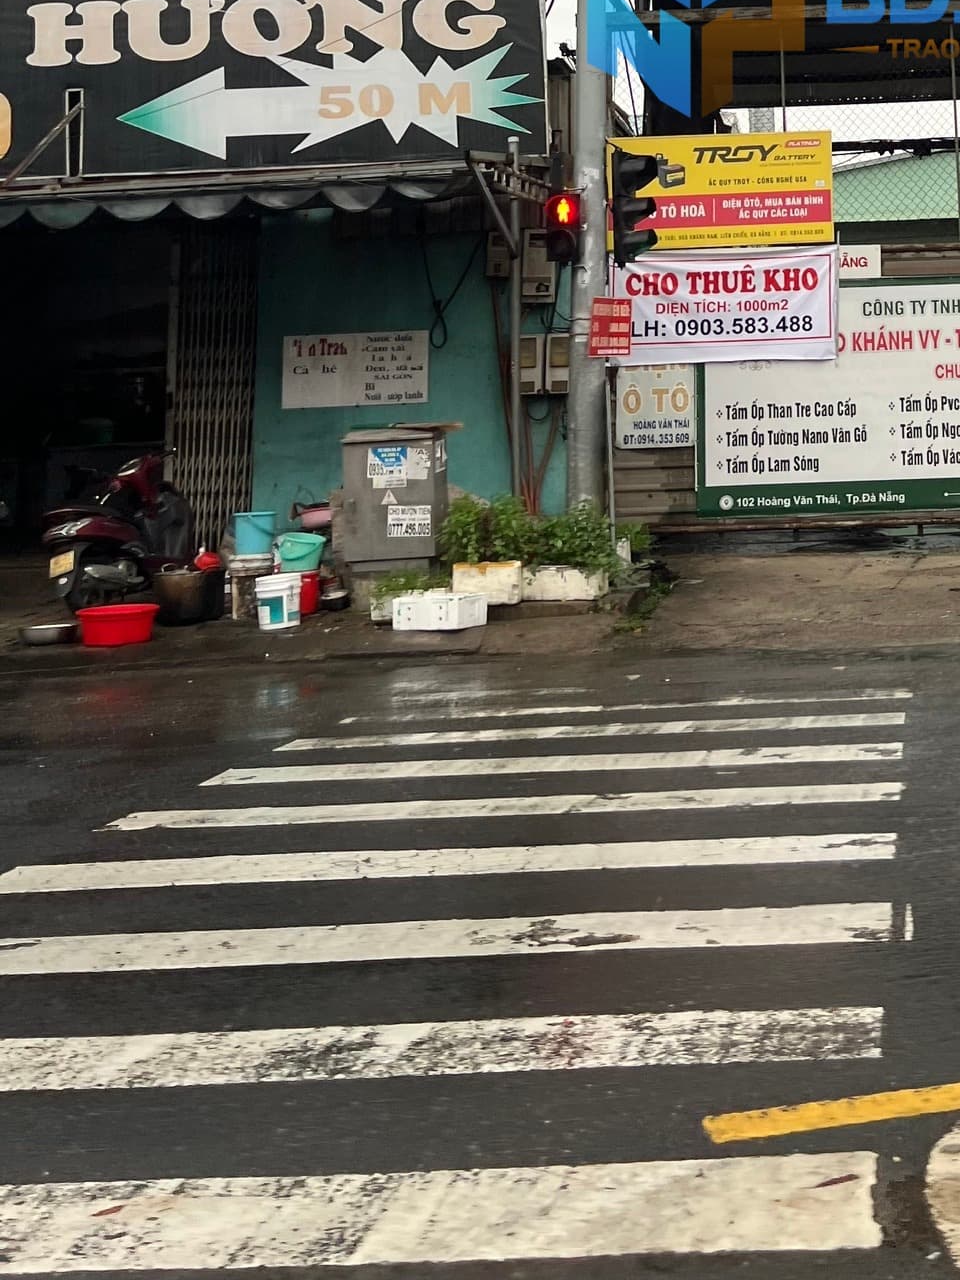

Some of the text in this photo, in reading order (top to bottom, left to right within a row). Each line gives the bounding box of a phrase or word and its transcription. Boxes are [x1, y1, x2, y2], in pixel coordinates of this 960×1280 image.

[318, 81, 471, 119] 50 M
[693, 143, 780, 164] TROY
[660, 202, 677, 218] TÔ
[680, 201, 706, 218] HOÀ
[765, 196, 783, 207] MUA
[752, 208, 768, 219] QUY
[771, 206, 787, 218] CÁC
[625, 264, 819, 296] CHO THUÊ KHO
[655, 298, 789, 318] DIỆN TÍCH: 1000m2
[863, 299, 904, 316] CÔNG
[910, 300, 927, 314] TY
[631, 315, 813, 338] LH: 0903.583.488
[852, 324, 913, 352] KHÁNH
[918, 328, 940, 349] VY
[623, 382, 689, 414] Ô TÔ
[725, 400, 748, 420] Tấm
